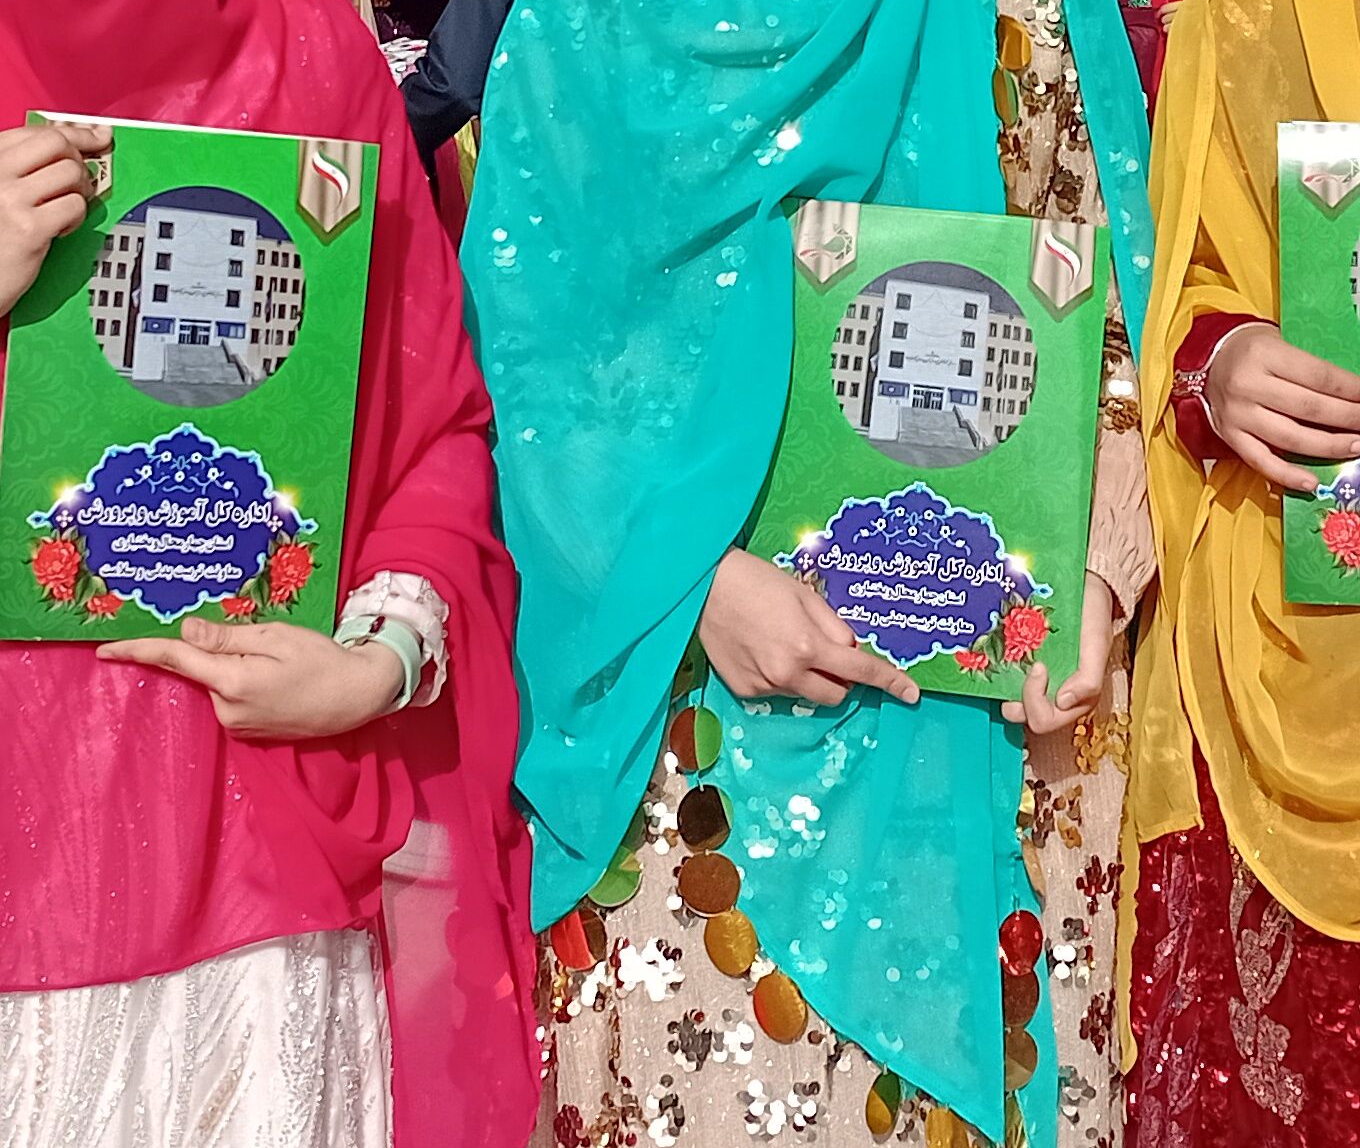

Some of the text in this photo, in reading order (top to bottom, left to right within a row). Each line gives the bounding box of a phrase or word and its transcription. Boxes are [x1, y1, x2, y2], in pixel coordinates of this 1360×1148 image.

[77, 497, 271, 528] اداره کل آموزش و پرورش
[111, 533, 153, 552] بختیاری
[204, 534, 234, 551] استان
[99, 561, 136, 577] سلامت
[134, 566, 145, 580] و
[818, 544, 1004, 586] اداره کل آموزش و پرورش
[848, 579, 888, 598] بختیاری
[938, 590, 966, 606] استان
[837, 605, 871, 622] سلامت
[869, 612, 879, 626] و
